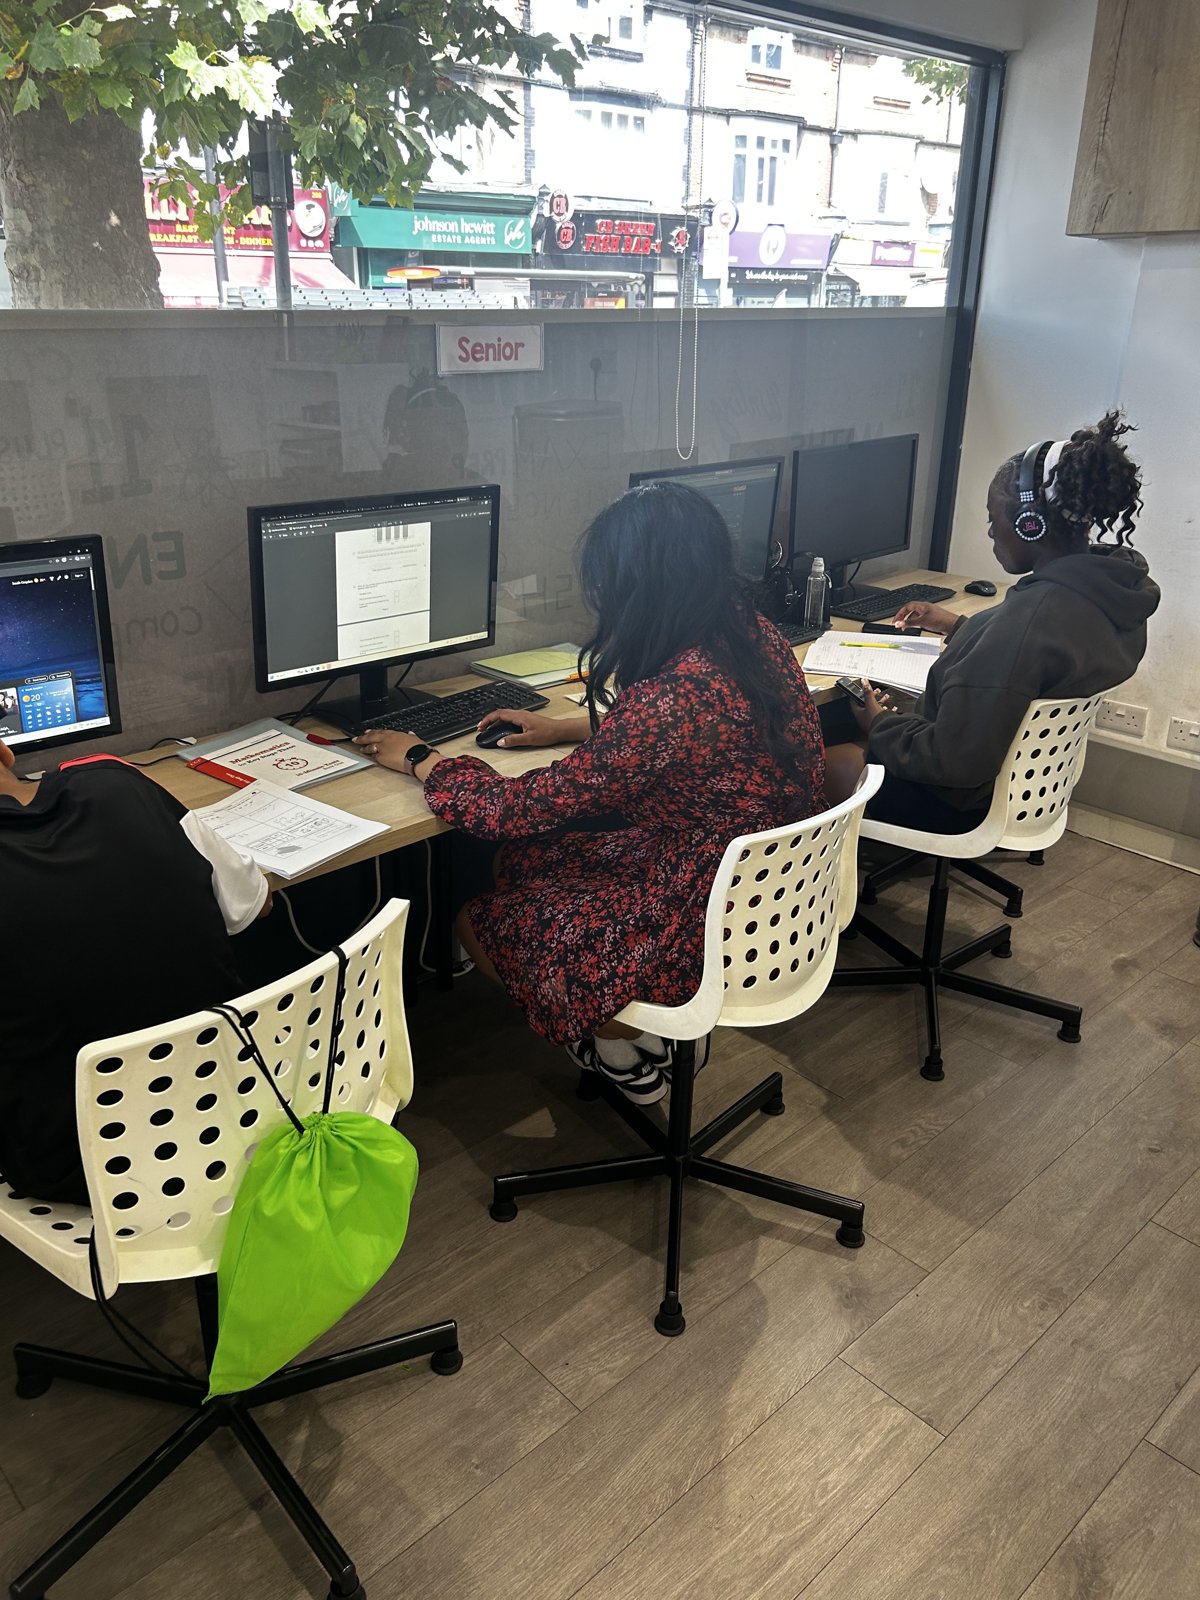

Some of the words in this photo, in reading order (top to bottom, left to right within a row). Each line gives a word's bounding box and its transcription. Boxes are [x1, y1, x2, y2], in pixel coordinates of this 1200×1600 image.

[412, 215, 458, 235] johnson
[461, 217, 496, 234] hewitt
[431, 233, 462, 243] ESTATE
[464, 235, 496, 245] AGENTS
[583, 233, 620, 253] FISH
[457, 336, 525, 363] Senior
[30, 693, 41, 702] 20
[229, 741, 290, 765] Mathematics
